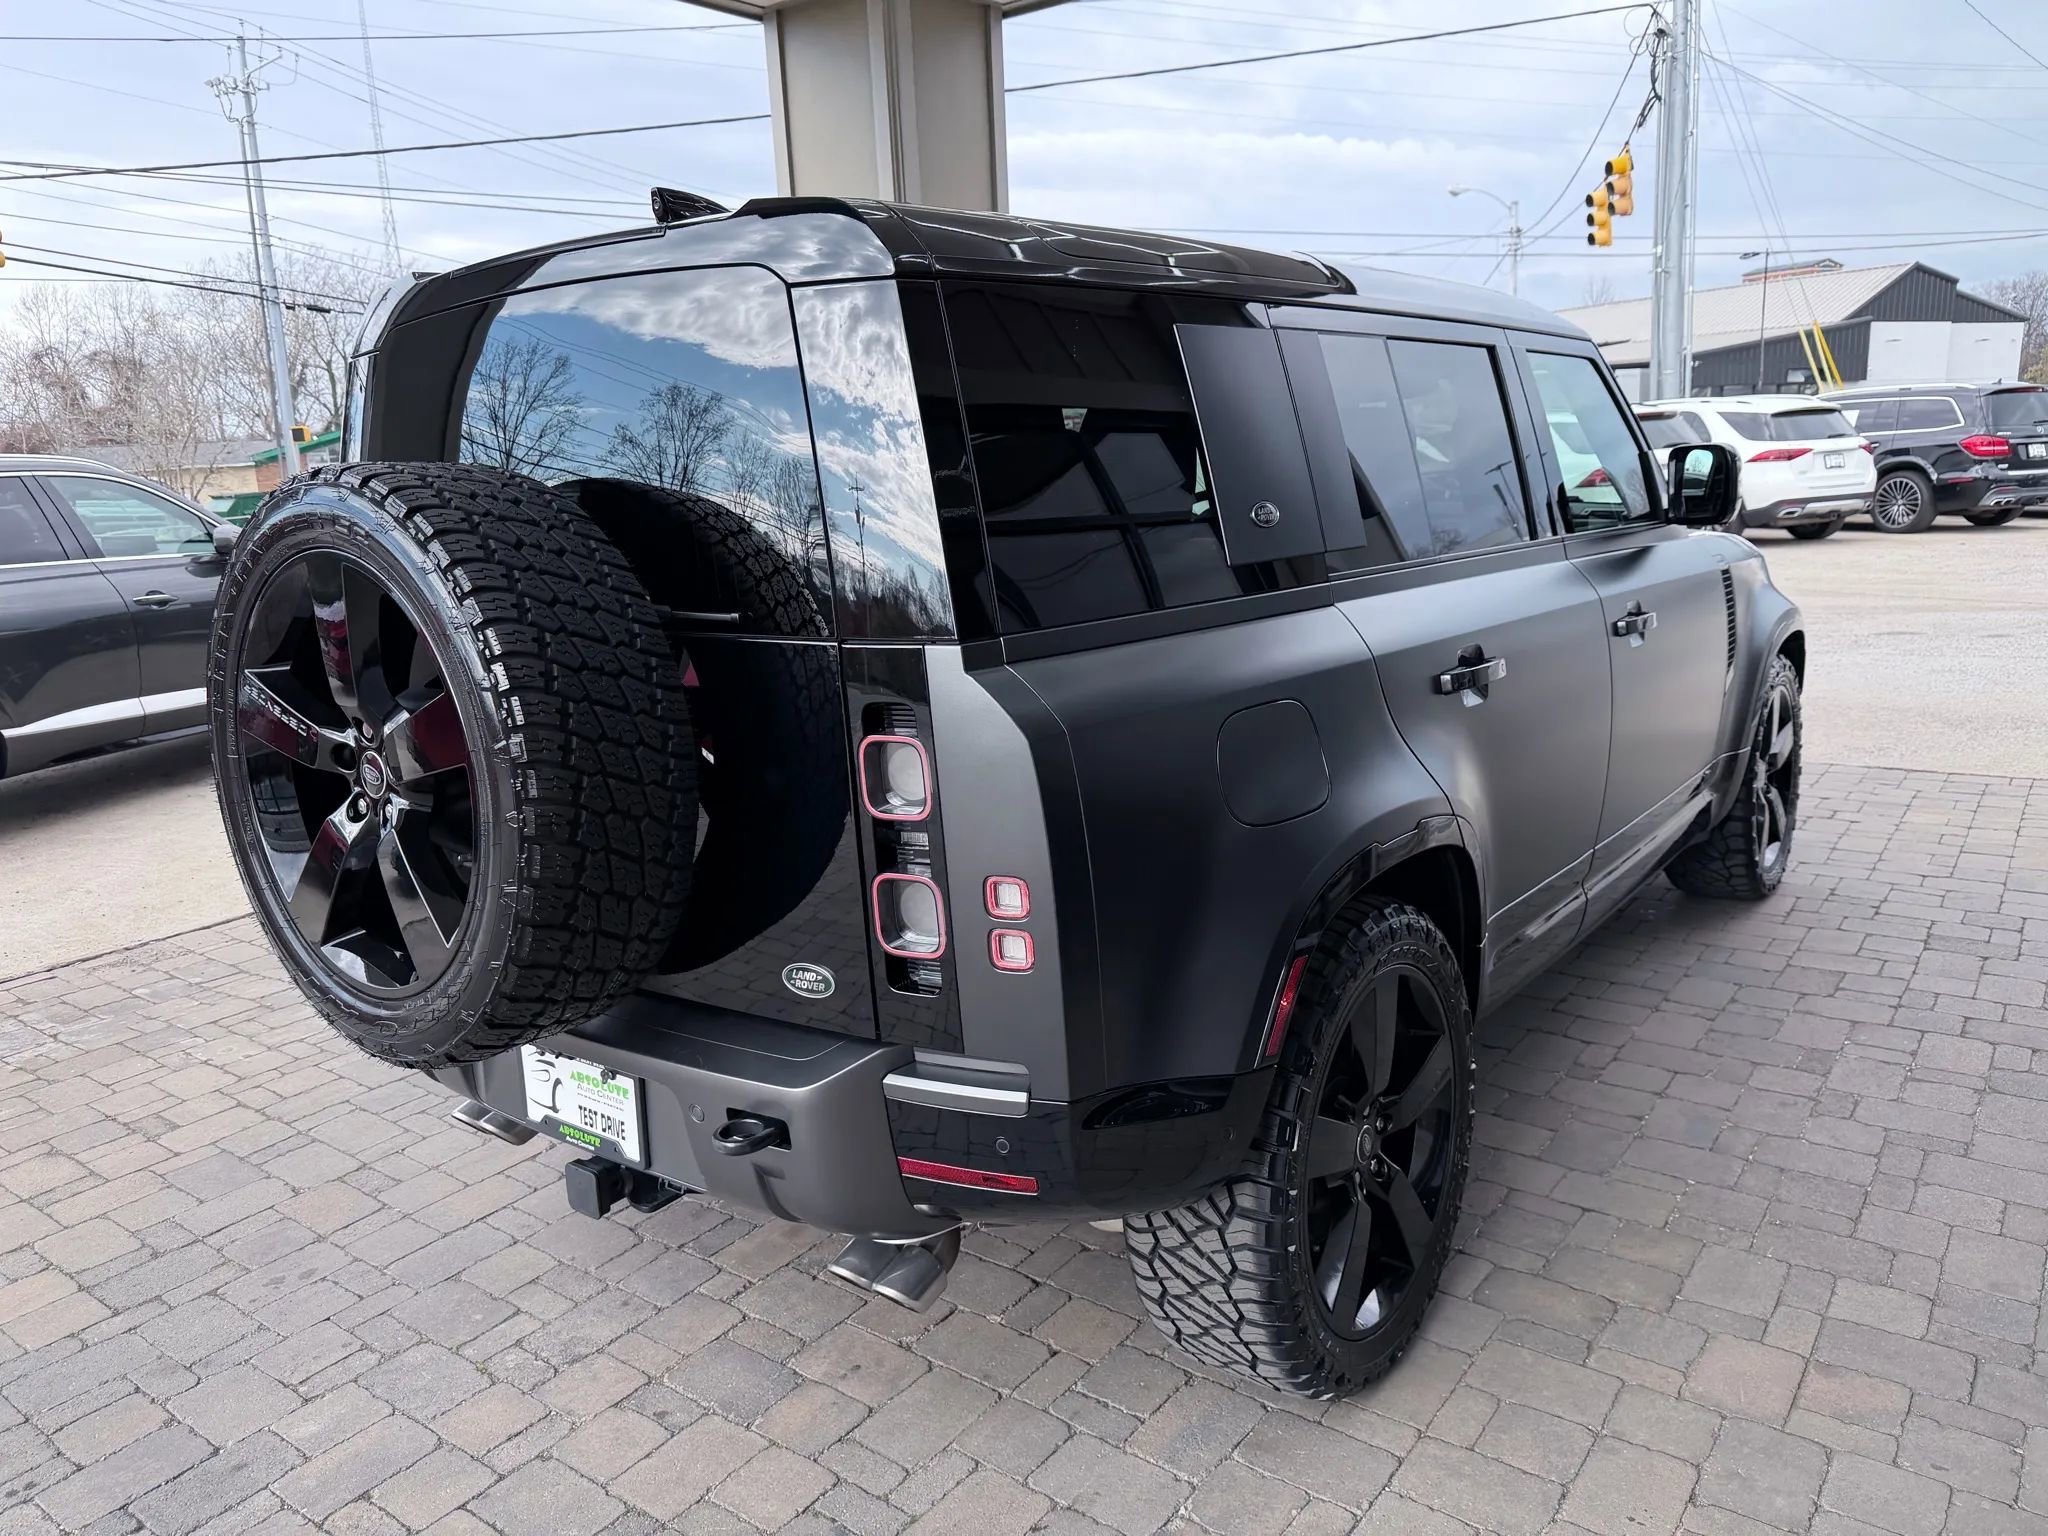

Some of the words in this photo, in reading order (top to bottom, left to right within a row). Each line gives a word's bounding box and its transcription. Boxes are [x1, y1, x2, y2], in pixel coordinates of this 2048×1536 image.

[792, 969, 817, 981] LAND
[795, 980, 825, 992] ROVER
[597, 1089, 624, 1105] CENTER
[578, 1104, 598, 1130] TEST
[600, 1113, 625, 1140] DRIVE
